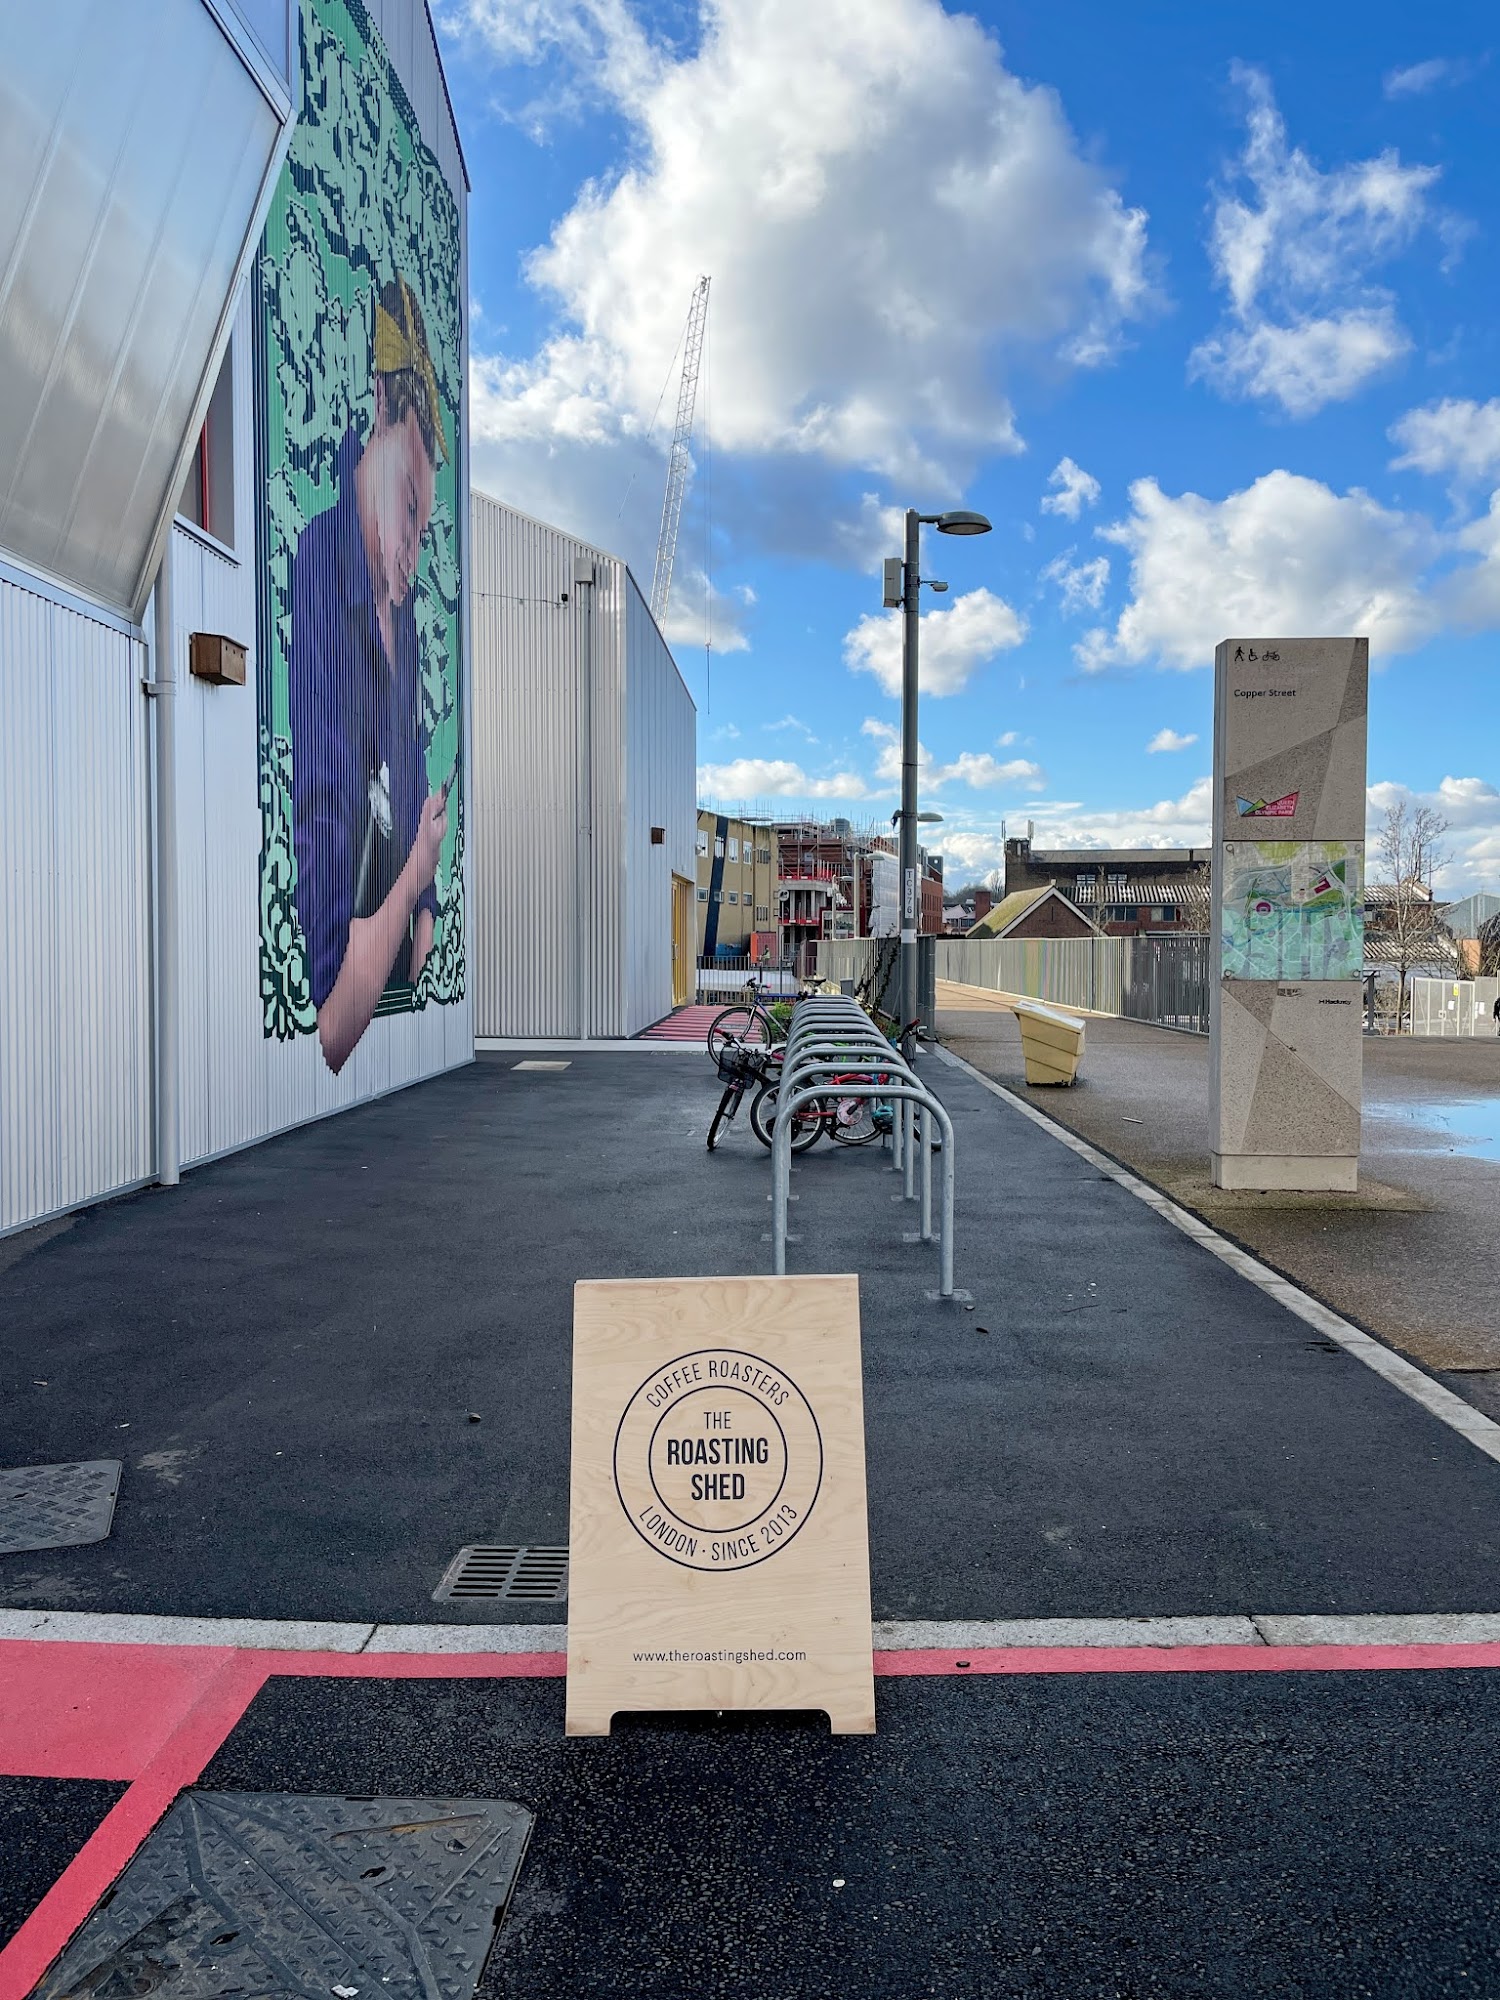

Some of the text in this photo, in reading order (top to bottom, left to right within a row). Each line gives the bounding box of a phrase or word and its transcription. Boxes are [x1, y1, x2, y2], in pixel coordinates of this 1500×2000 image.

[1234, 689, 1297, 699] Copper Street
[646, 1360, 789, 1407] COFFEE ROASTERS
[703, 1411, 732, 1430] THE
[667, 1437, 769, 1465] ROASTING
[691, 1473, 745, 1501] SHED
[639, 1504, 797, 1561] LONDON SINCE 2013
[633, 1650, 807, 1664] www.theroastingshed.com
